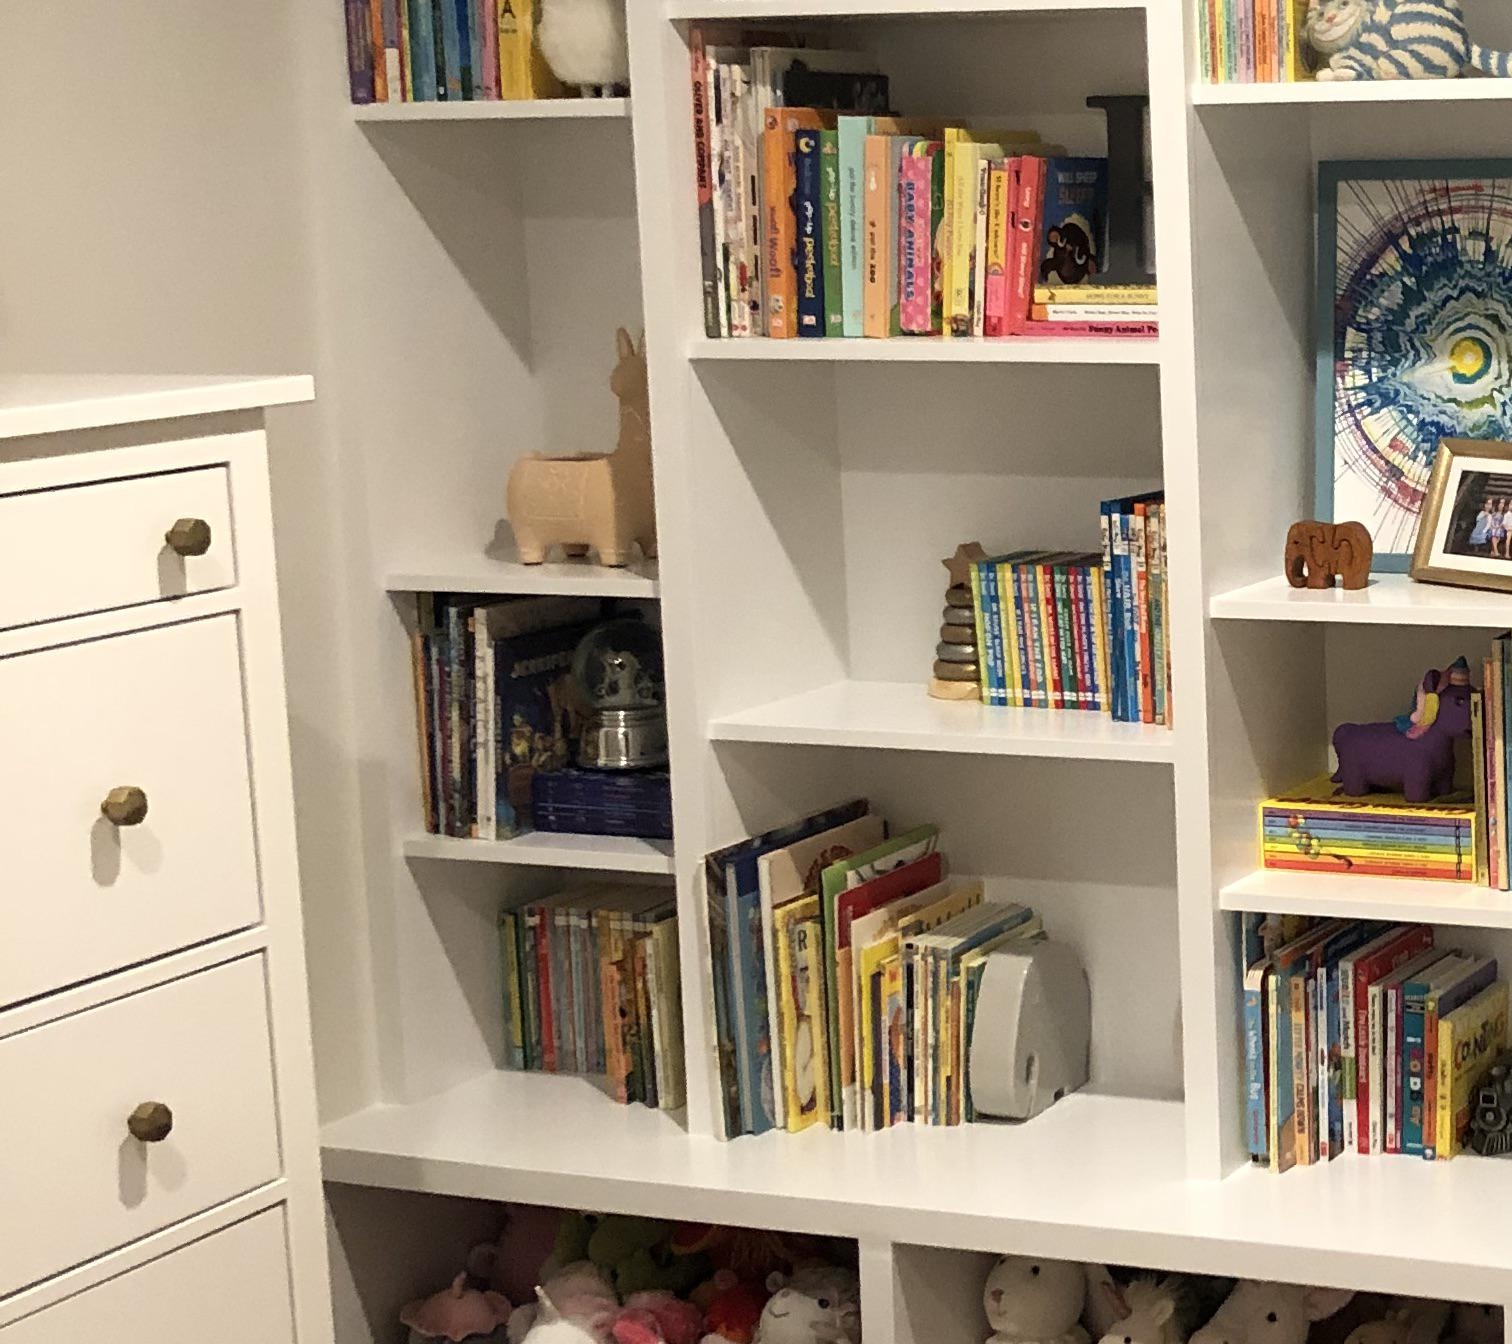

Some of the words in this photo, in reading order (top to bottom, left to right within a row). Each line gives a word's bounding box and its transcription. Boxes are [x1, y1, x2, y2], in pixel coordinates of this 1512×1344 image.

[906, 182, 914, 222] BABY
[906, 229, 914, 299] ANIMALS
[1115, 325, 1145, 333] Animal
